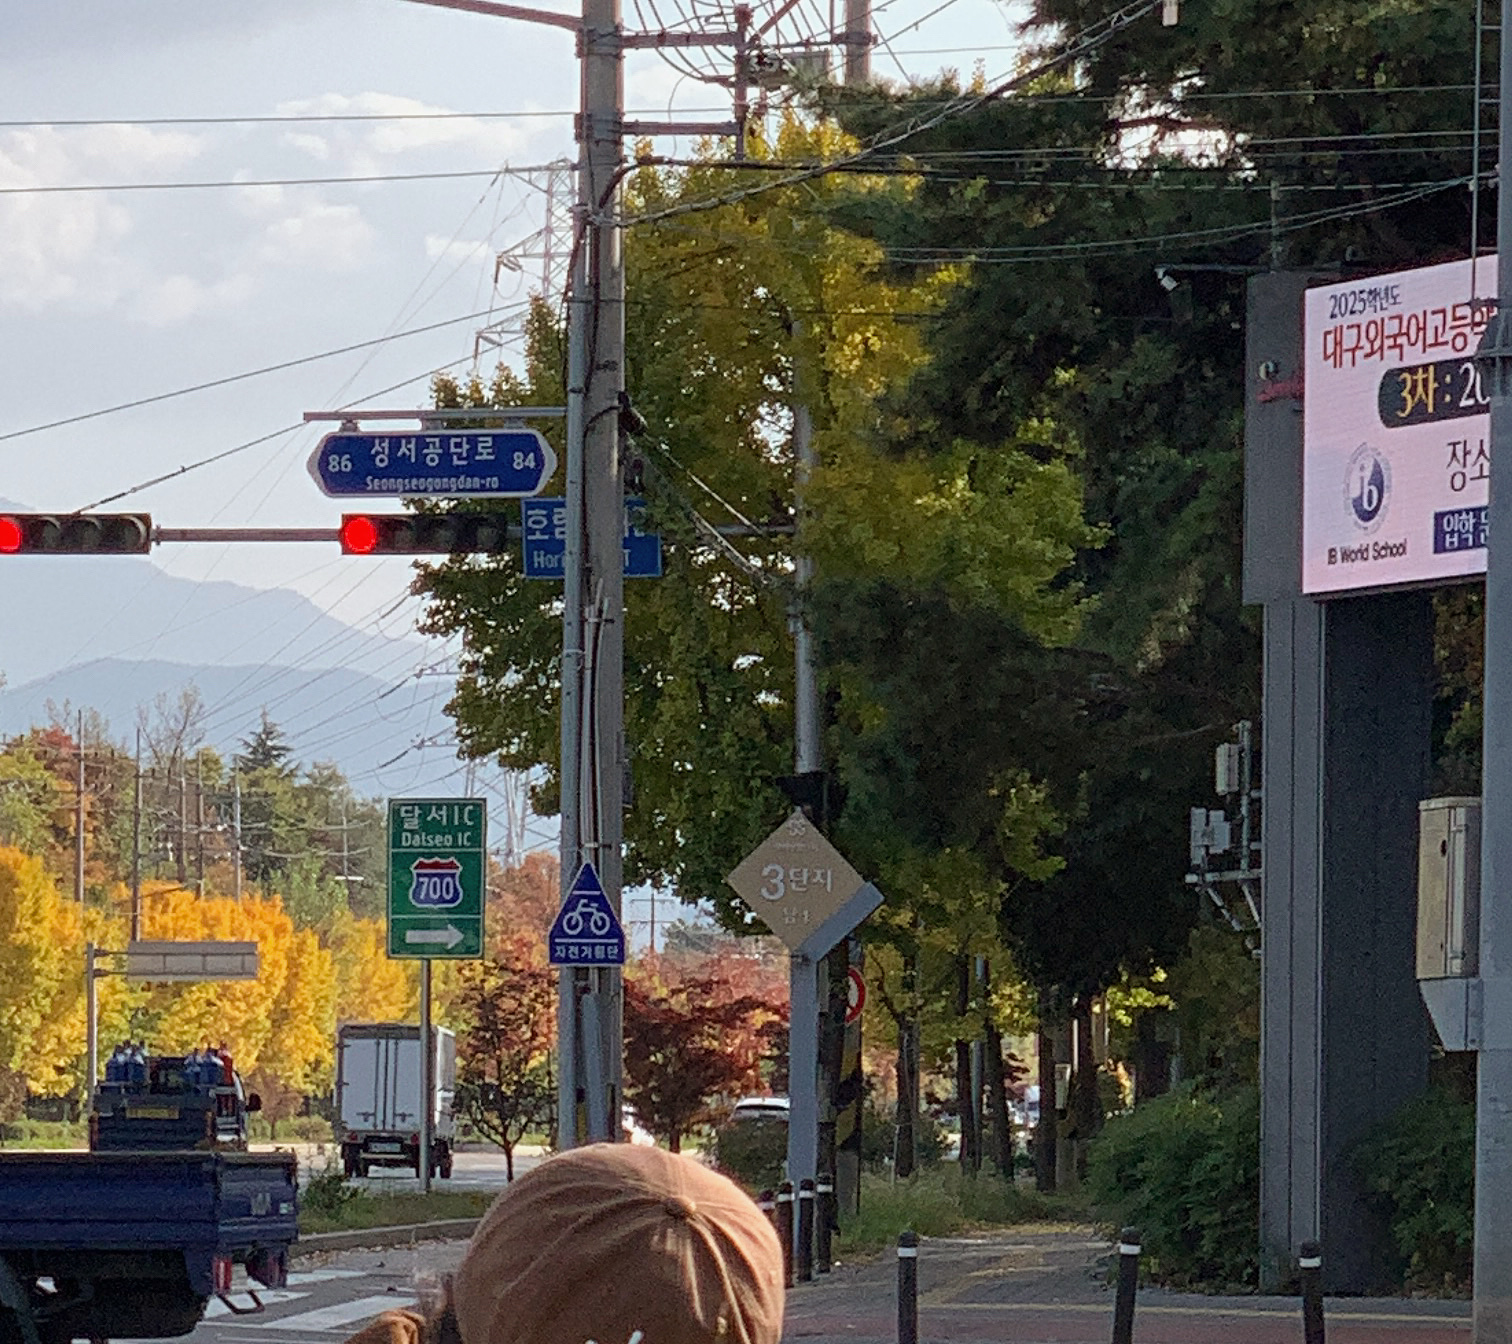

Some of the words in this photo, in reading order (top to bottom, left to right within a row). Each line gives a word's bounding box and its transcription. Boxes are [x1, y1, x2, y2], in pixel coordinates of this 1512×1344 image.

[1329, 284, 1402, 319] 2025학년도
[1322, 302, 1493, 369] 대구외국어고등학
[1396, 364, 1439, 417] 3차
[327, 455, 353, 473] 86
[370, 436, 496, 467] 성서공단로
[512, 451, 536, 470] 84
[365, 475, 499, 494] Seongseogongdan-ro
[1327, 547, 1337, 566] IB
[1340, 543, 1369, 564] World
[1372, 538, 1407, 561] School
[401, 832, 452, 848] Dalseo
[458, 831, 472, 848] IC
[418, 876, 455, 900] 700
[760, 863, 833, 901] 3단지
[554, 944, 619, 960] 자전거횡단
